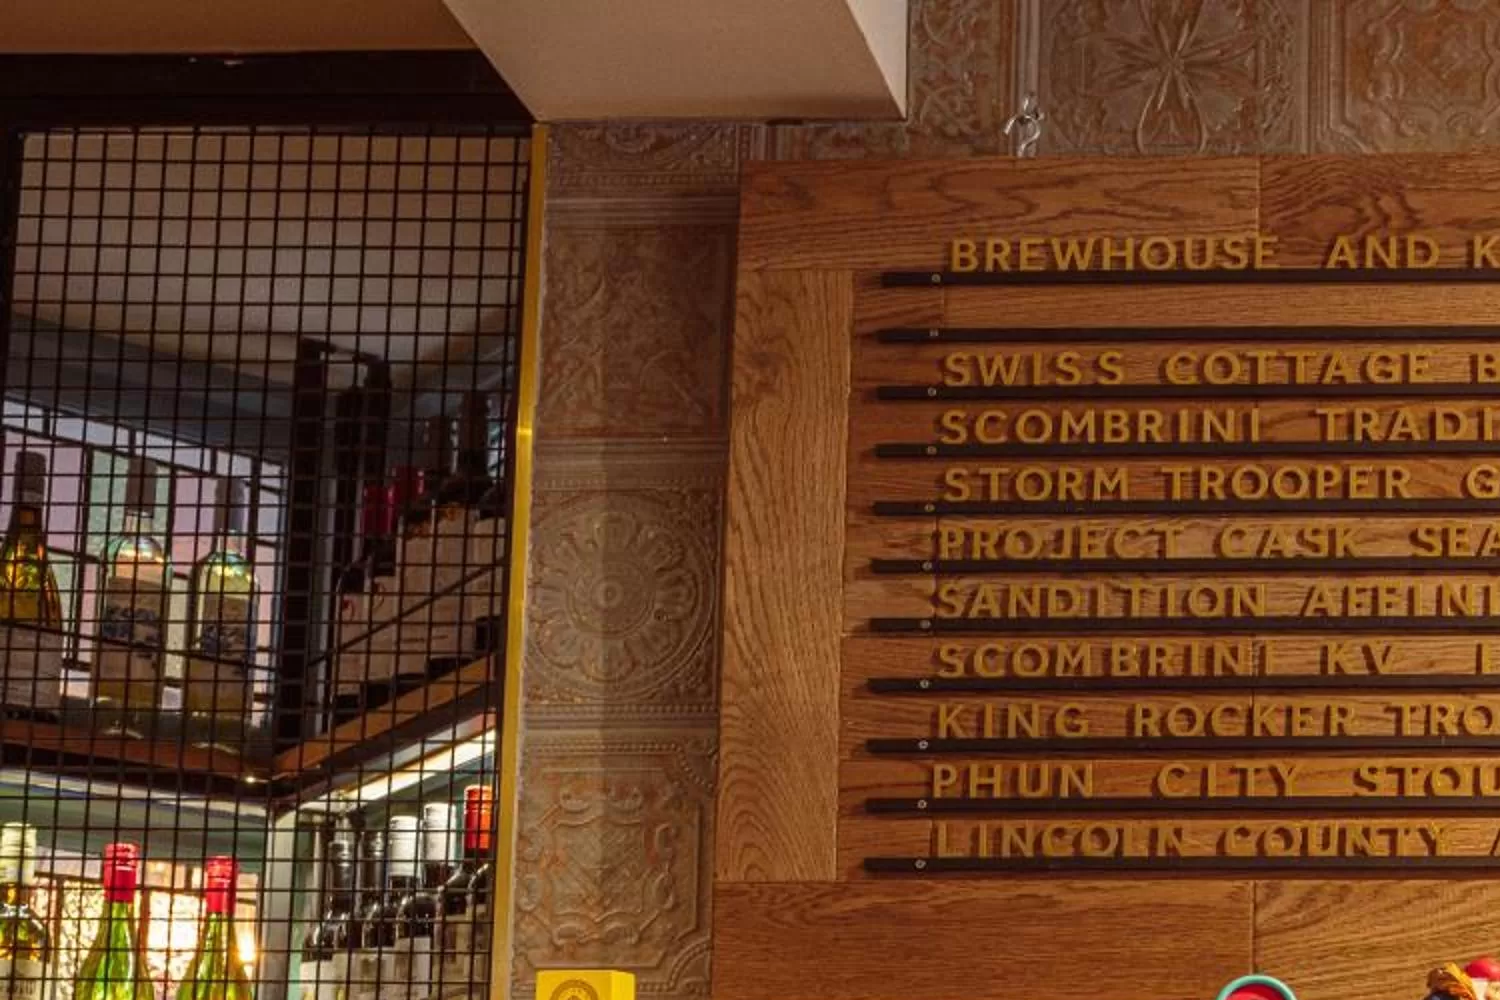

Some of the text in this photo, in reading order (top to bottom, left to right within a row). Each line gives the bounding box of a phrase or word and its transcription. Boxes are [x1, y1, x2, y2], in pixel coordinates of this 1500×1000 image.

[951, 236, 1279, 272] BREWHOUSE
[1326, 236, 1440, 270] AND
[944, 351, 1125, 386] SWISS
[1167, 350, 1433, 386] COTTAGE
[940, 408, 1261, 445] SCOMBRINI
[943, 467, 1129, 502] STORM
[1162, 465, 1411, 501] TROOPER
[938, 523, 1184, 560] PROJECT
[1220, 523, 1361, 559] CASK
[934, 582, 1265, 619] SANDITION
[938, 642, 1275, 678] SCOMBRINI
[1325, 641, 1397, 677] KV
[938, 703, 1090, 738] KING
[1134, 702, 1359, 738] ROCKER
[932, 764, 1095, 799] PHUN
[1158, 763, 1300, 799] CITY
[936, 822, 1188, 858] LINCOLN
[1224, 822, 1449, 858] COUNTY
